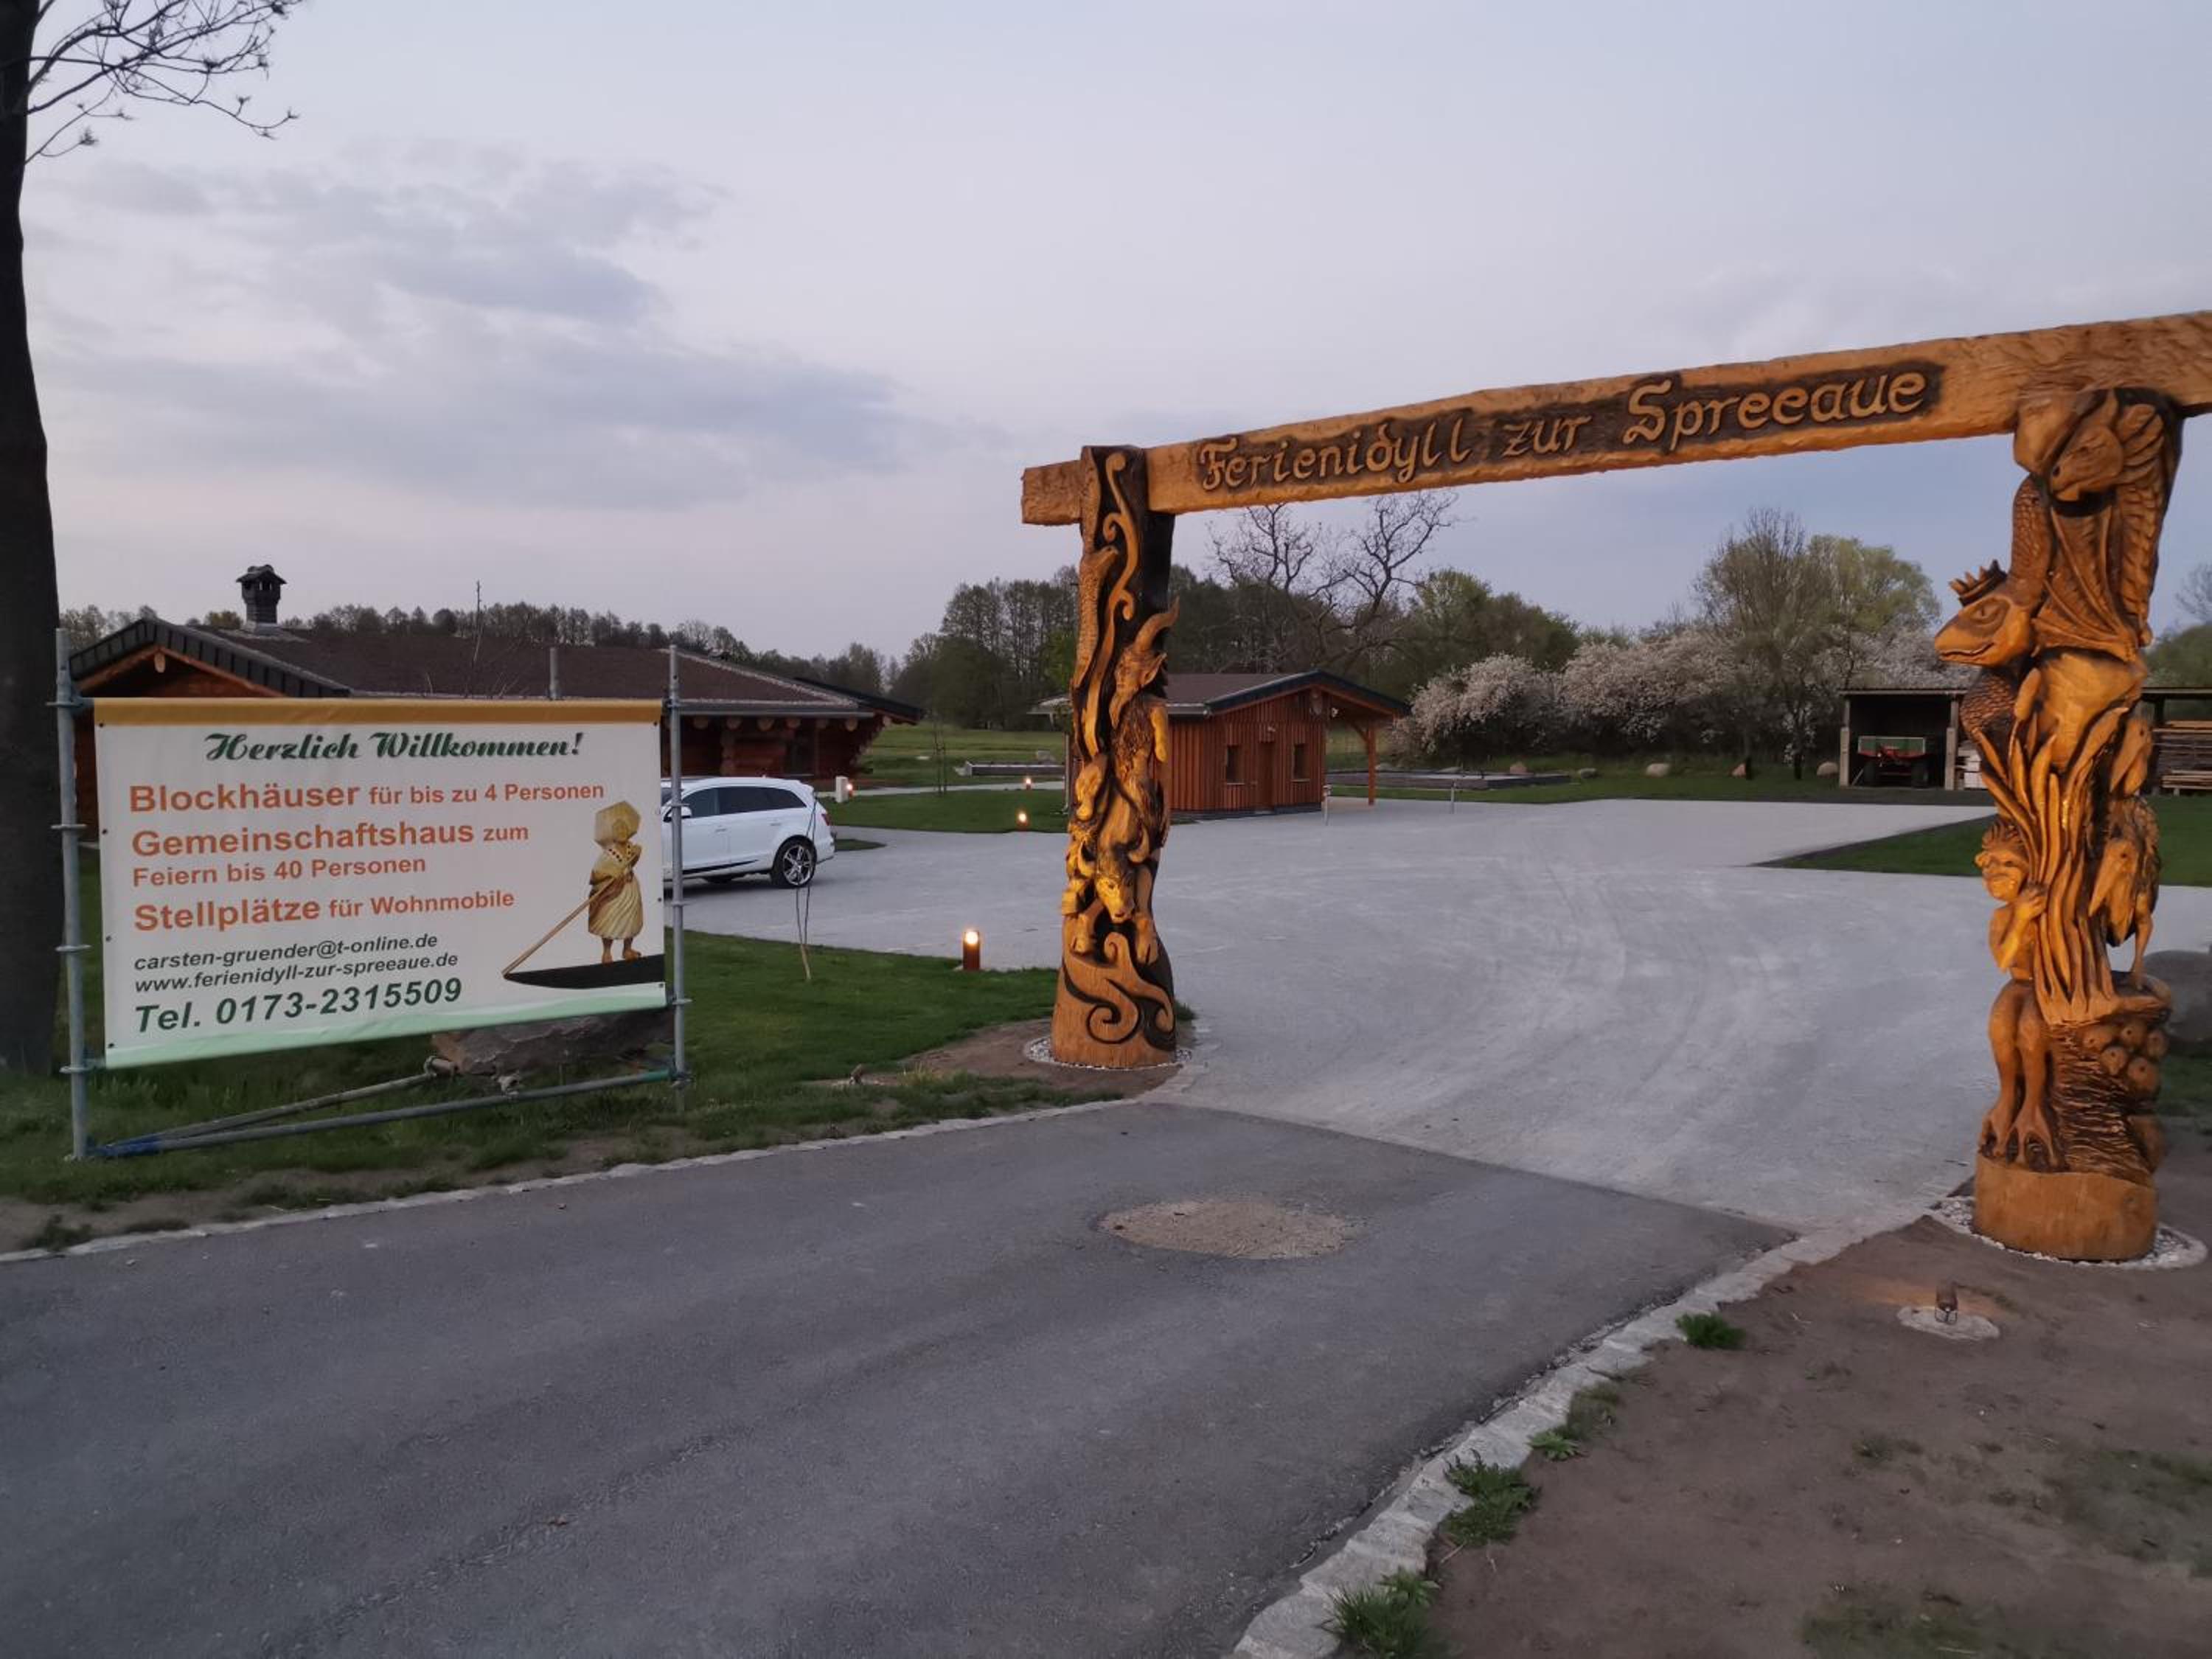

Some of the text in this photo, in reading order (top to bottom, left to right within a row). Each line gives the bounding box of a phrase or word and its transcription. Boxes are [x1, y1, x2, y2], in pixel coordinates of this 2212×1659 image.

[1502, 414, 1593, 457] zur
[1622, 370, 1927, 452] Spreeaue
[204, 732, 584, 761] Herzlich Willkommen!
[130, 782, 604, 812] Blockhäuser für bis zu 4 Personen
[132, 821, 529, 856] Gemeinschaftshaus zum
[133, 858, 425, 886] Feiern bis 40 Personen
[134, 890, 515, 931] Stellplätze für Wohnmobile
[134, 933, 438, 970] carsten-gruender@t-online.de
[135, 953, 459, 992] www.ferienidyll-zur-spreeaue.de
[135, 978, 462, 1033] Tel. 0173-2315509
